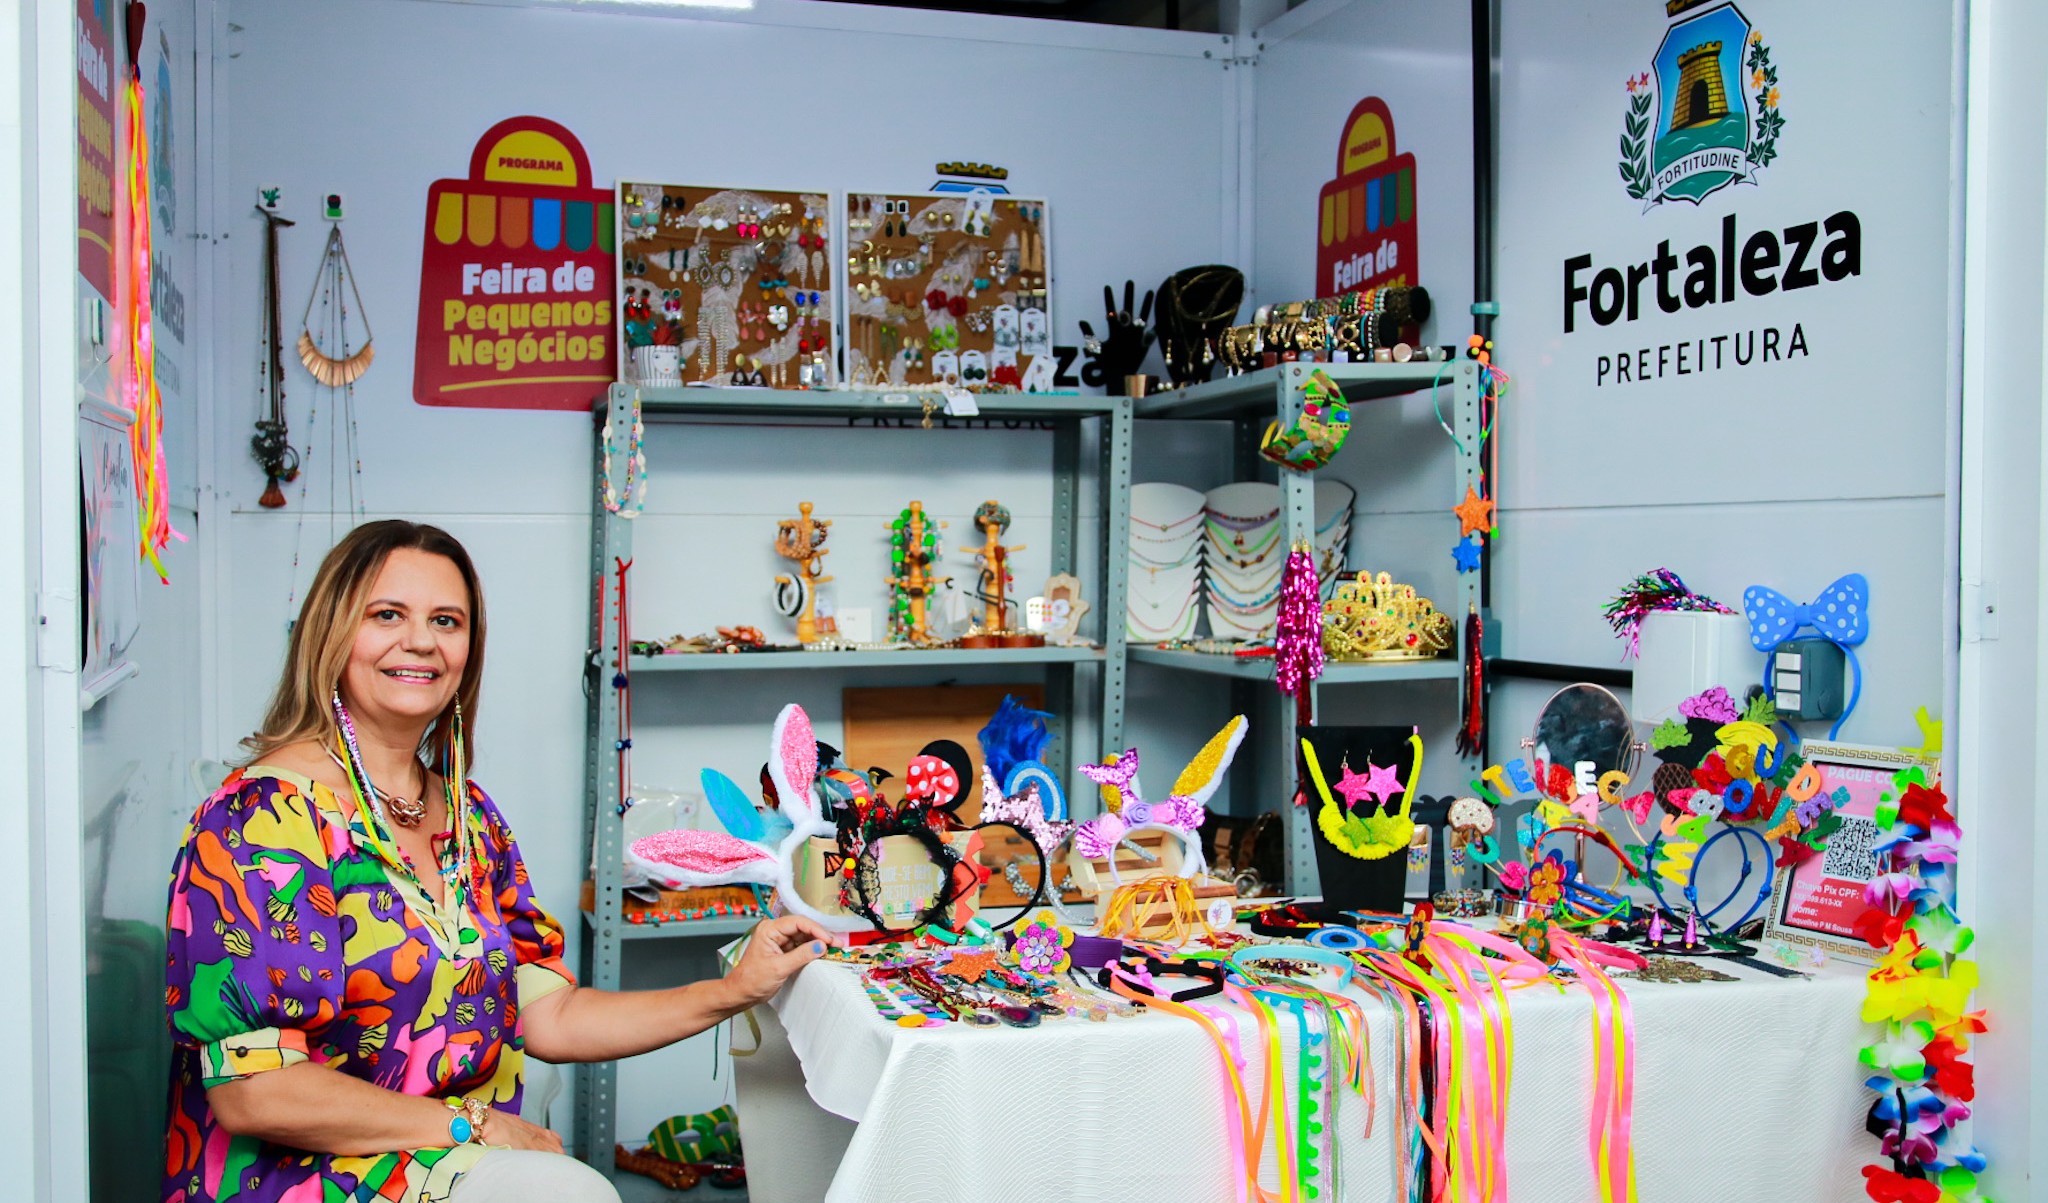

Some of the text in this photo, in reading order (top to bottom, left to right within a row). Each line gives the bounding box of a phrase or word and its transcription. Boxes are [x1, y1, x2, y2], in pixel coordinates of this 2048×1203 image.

[498, 156, 564, 172] PROGRAMA
[1657, 151, 1740, 190] FORTITUDINE
[462, 260, 595, 295] Feira de
[1333, 249, 1374, 294] Feira
[1375, 239, 1397, 275] de
[1563, 210, 1862, 334] Fortaleza
[443, 300, 612, 335] Pequenos
[449, 331, 606, 371] Negócios
[1597, 323, 1809, 387] PREFEITURA
[1827, 765, 1872, 783] PAGUE
[1823, 885, 1837, 895] Pix
[1838, 887, 1859, 899] CPF:
[1791, 904, 1819, 916] Nome:
